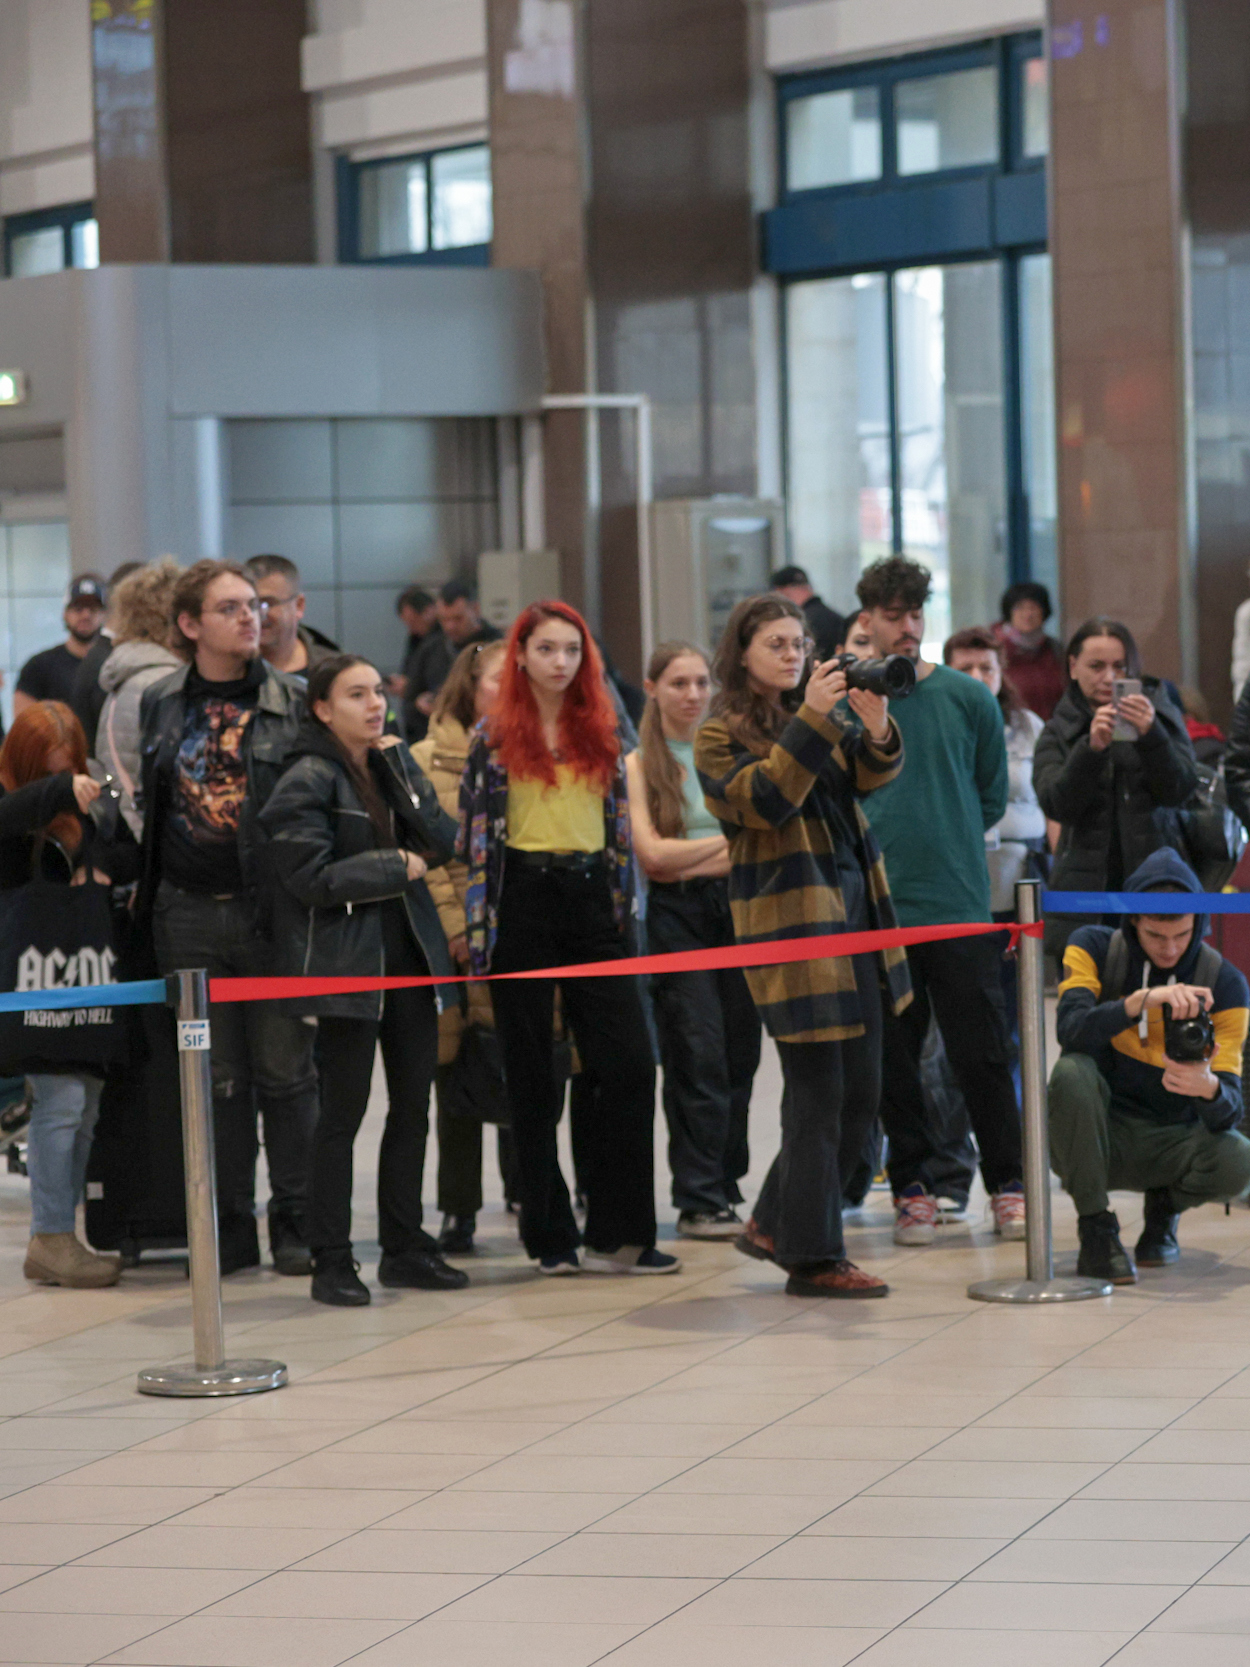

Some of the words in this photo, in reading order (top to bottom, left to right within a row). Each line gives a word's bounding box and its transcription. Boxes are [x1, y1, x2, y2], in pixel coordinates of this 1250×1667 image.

[14, 944, 119, 992] AC/DC
[74, 1008, 89, 1026] TO
[87, 1007, 115, 1025] HELL
[184, 1034, 205, 1047] SIF
